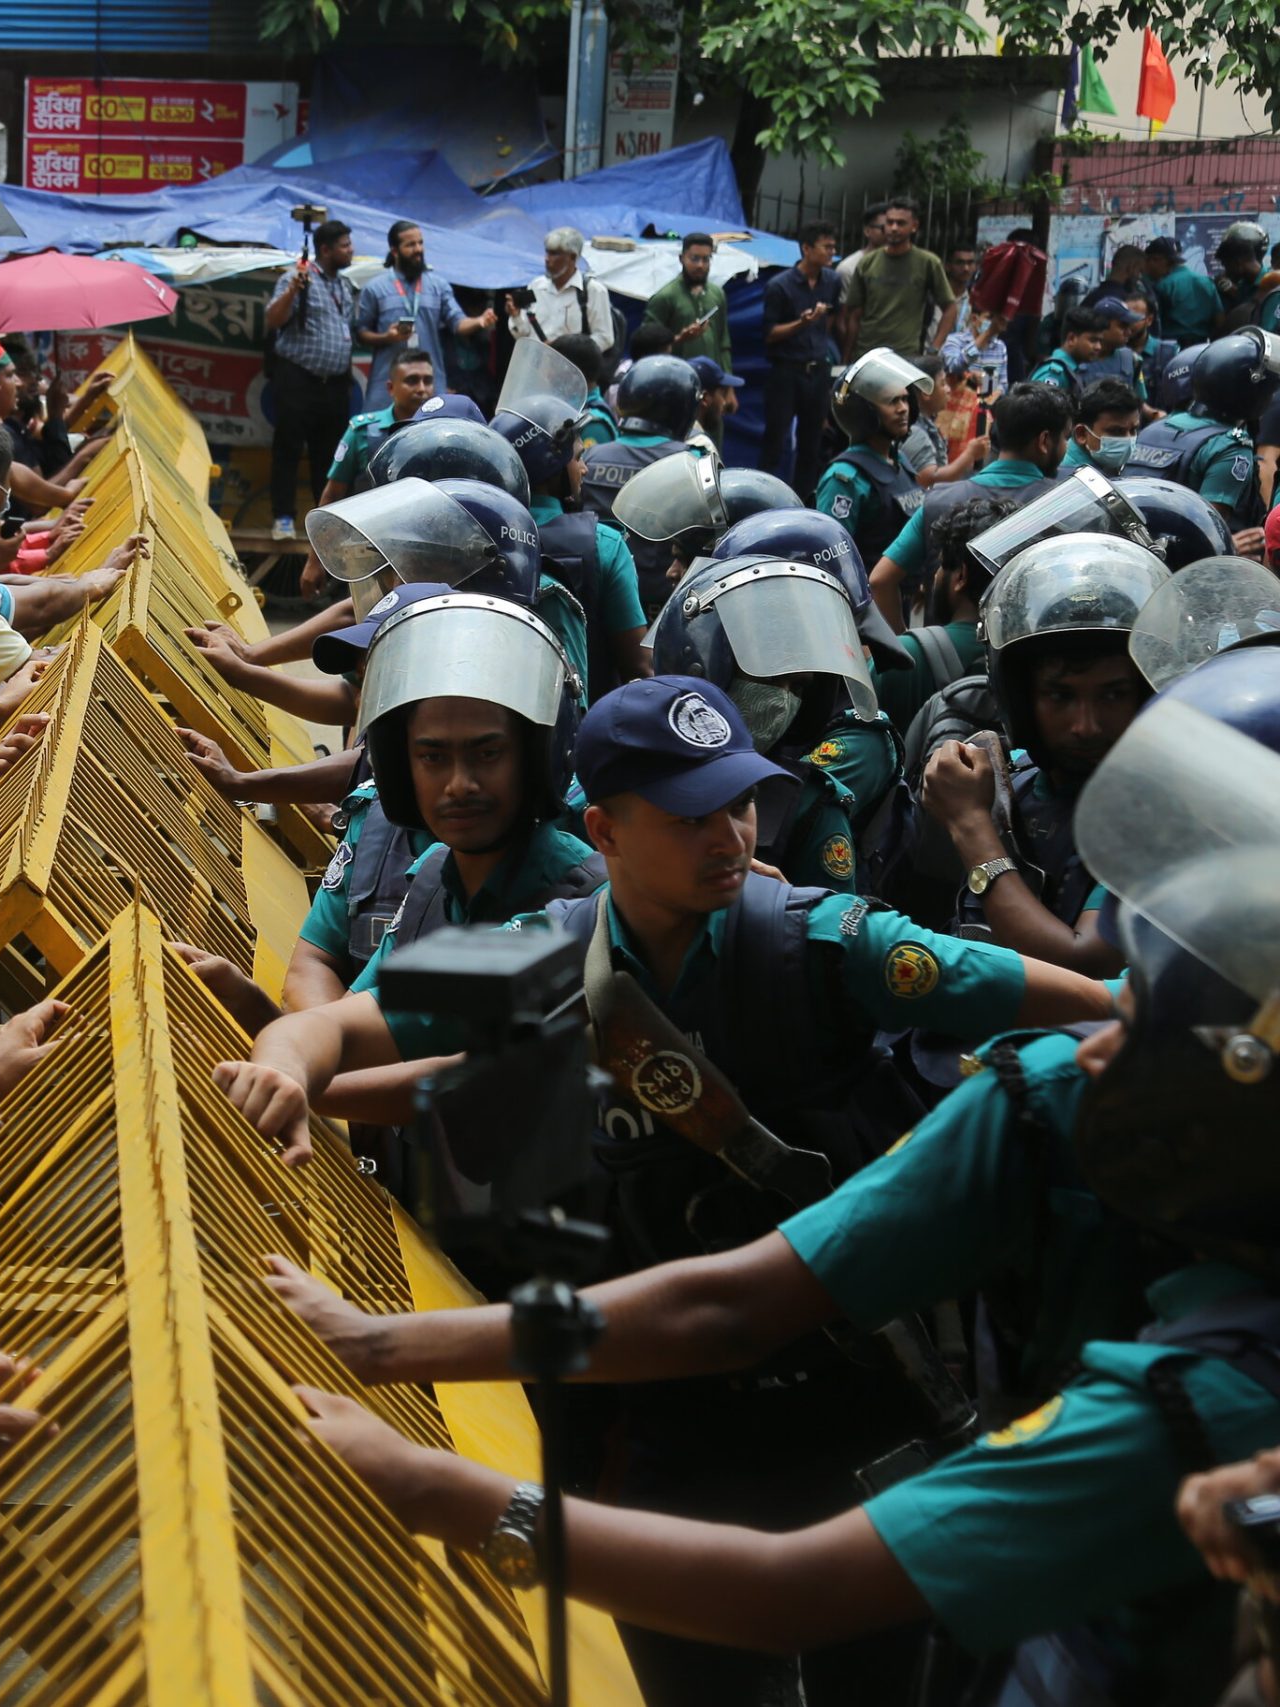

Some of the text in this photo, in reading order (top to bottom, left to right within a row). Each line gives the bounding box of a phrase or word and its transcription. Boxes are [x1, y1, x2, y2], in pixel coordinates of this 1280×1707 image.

[1168, 365, 1190, 379] POLICE
[500, 525, 536, 548] POLICE
[812, 540, 851, 566] POLICE
